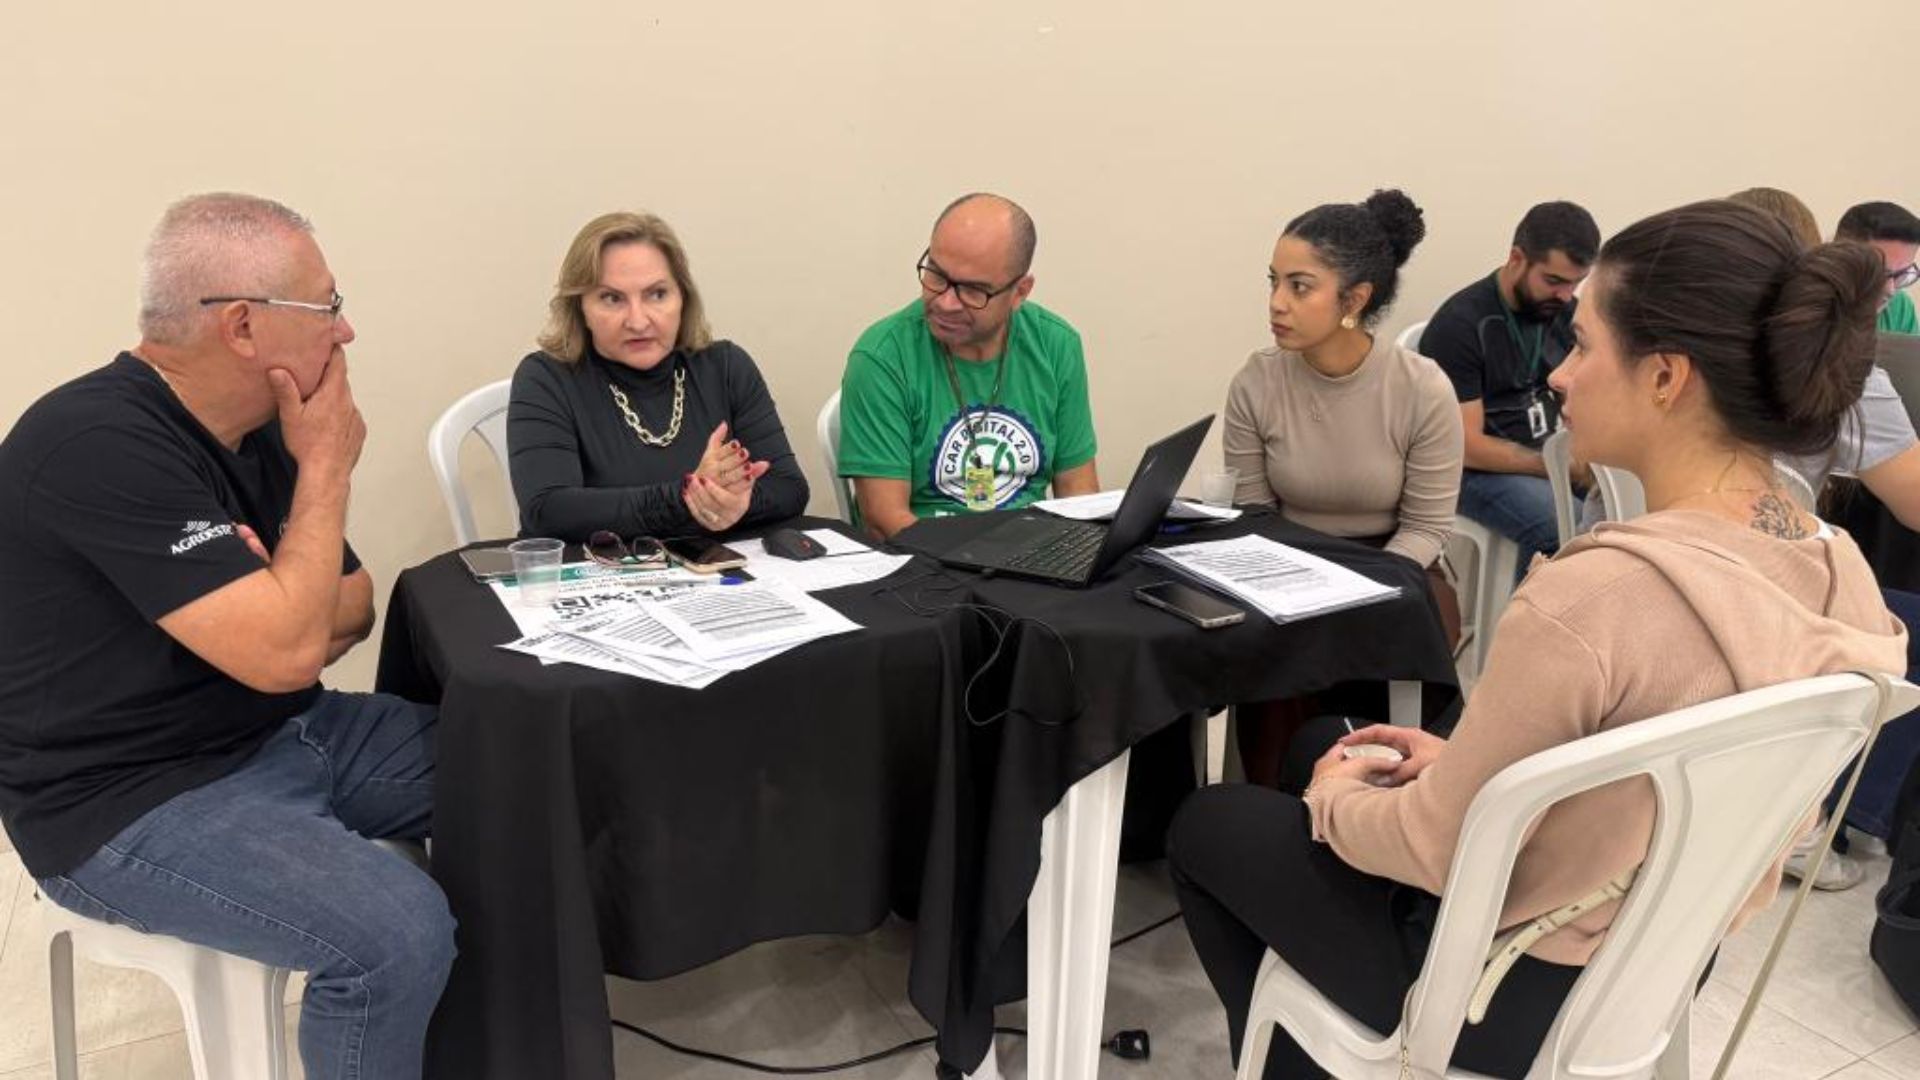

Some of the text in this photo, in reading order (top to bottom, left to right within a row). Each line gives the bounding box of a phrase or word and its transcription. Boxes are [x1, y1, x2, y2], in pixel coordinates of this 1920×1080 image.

[944, 421, 1032, 475] CAR DGITAL 2.0
